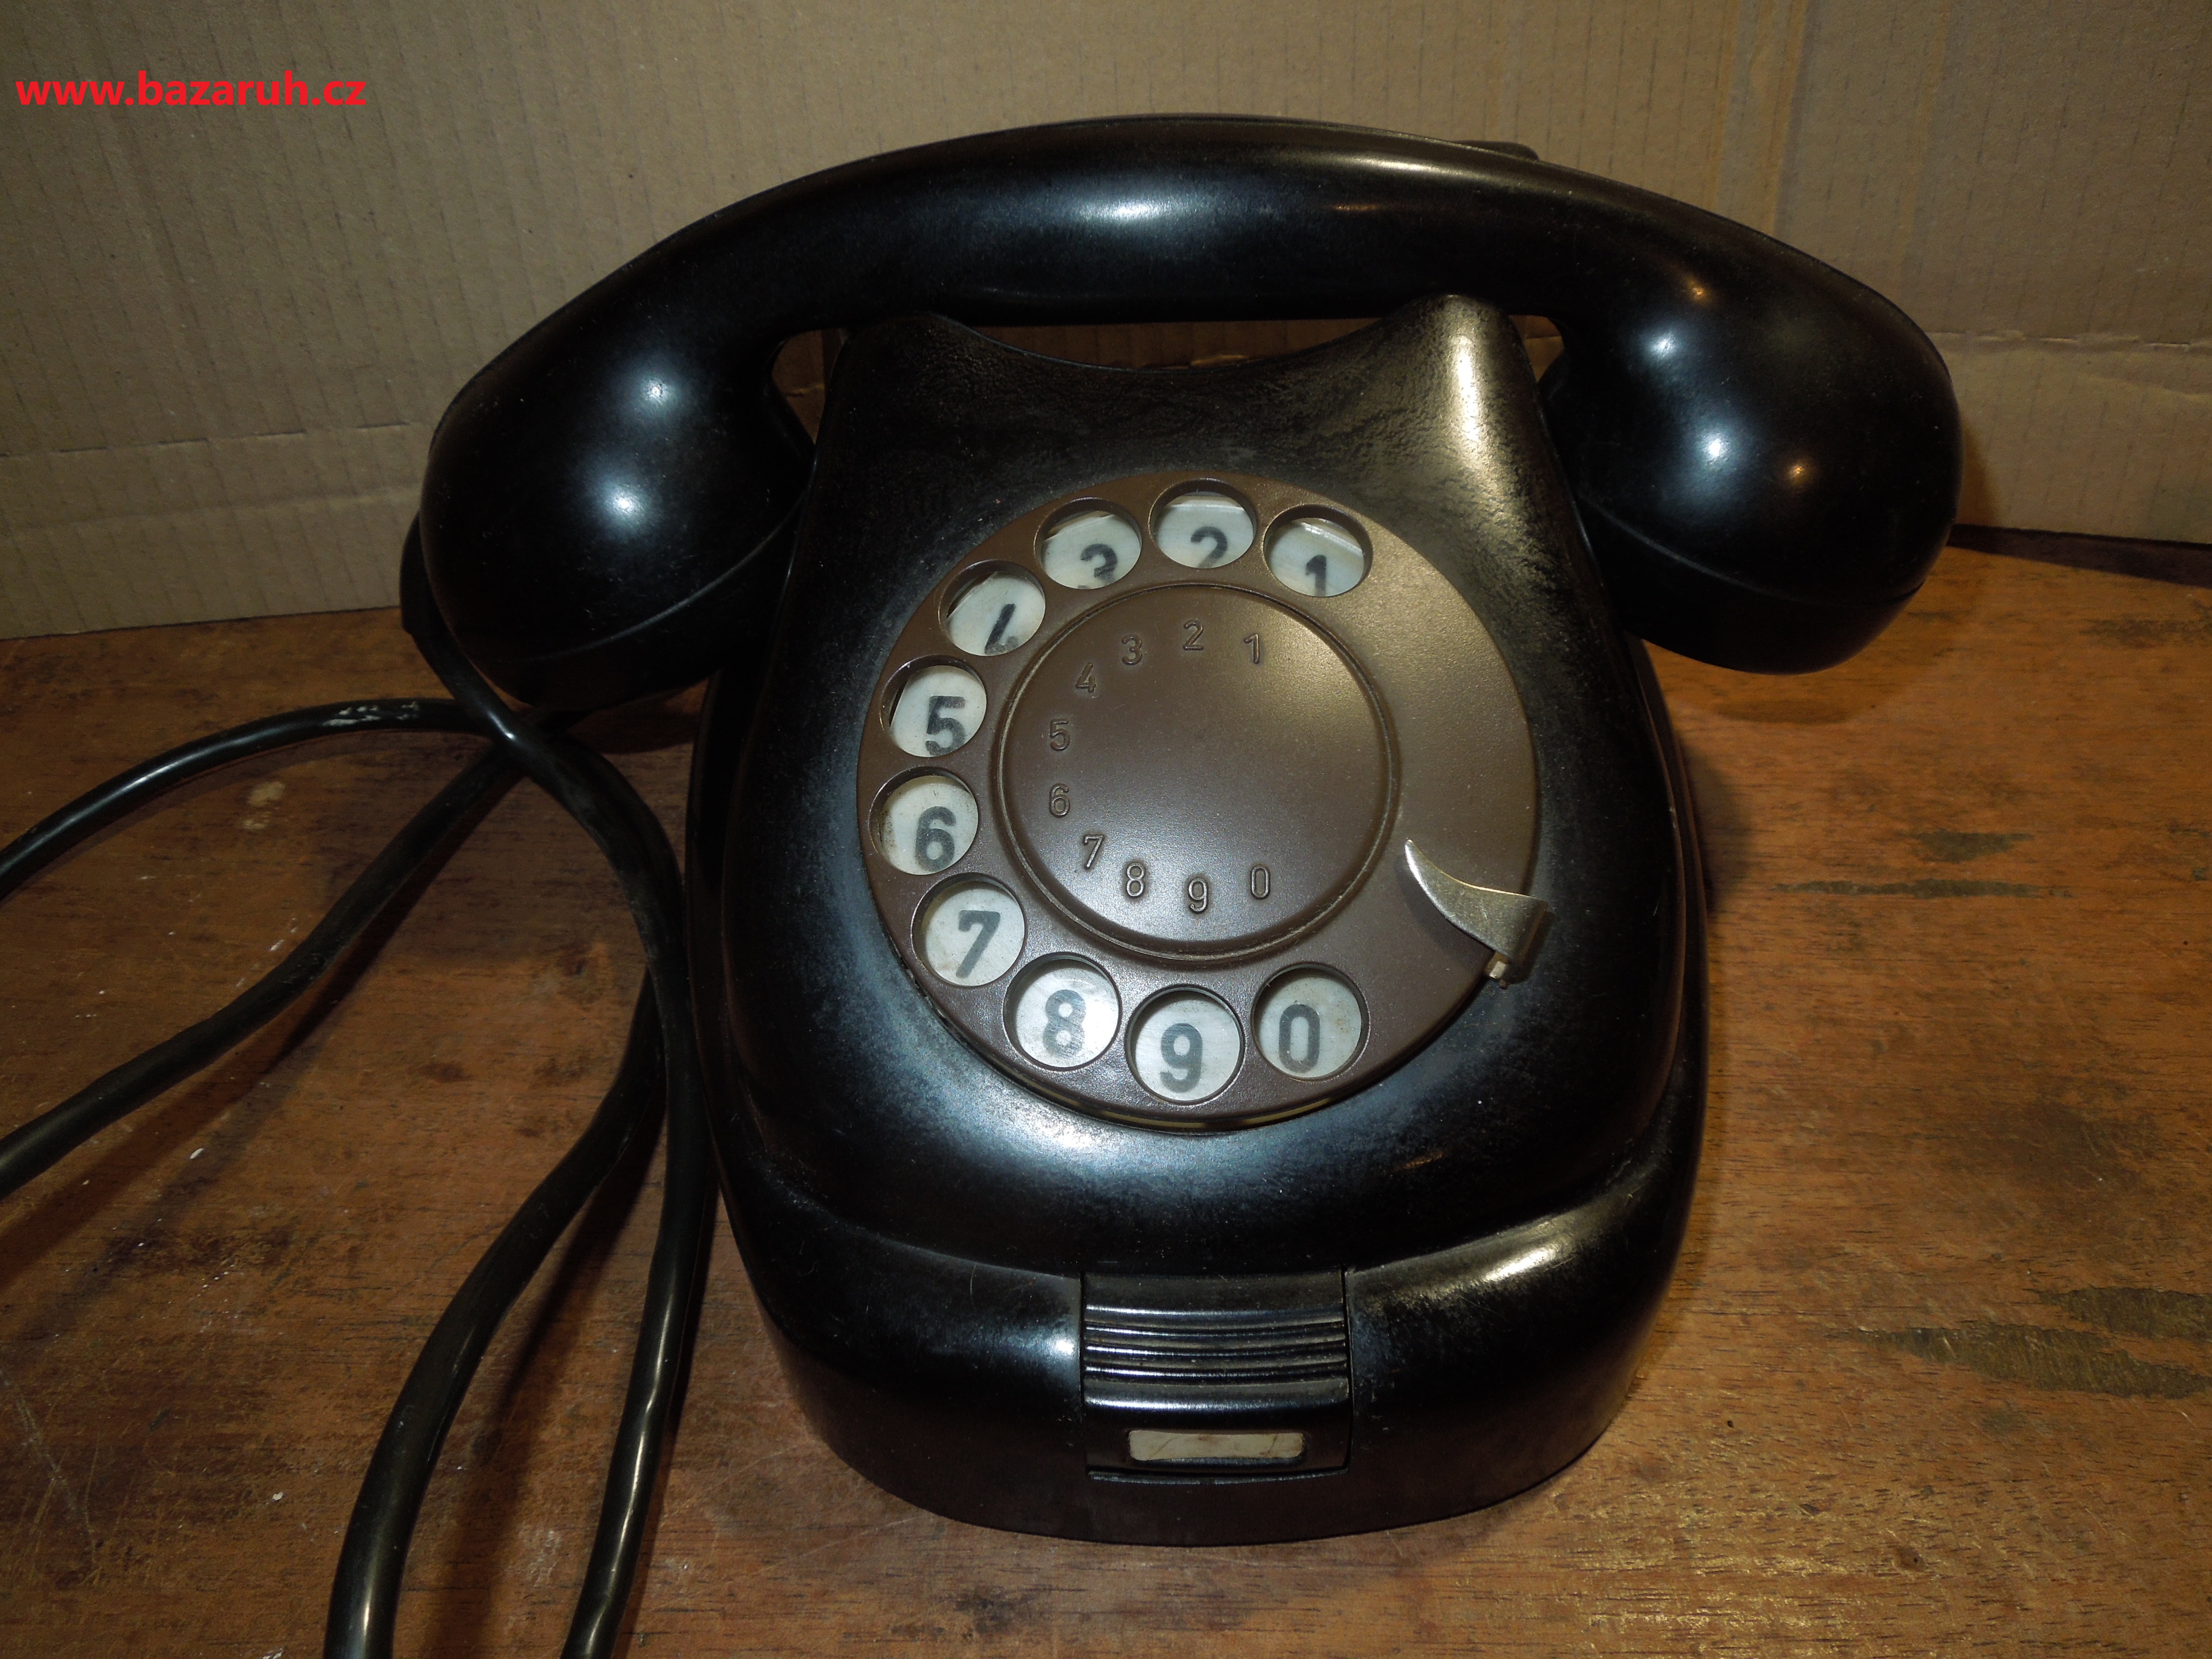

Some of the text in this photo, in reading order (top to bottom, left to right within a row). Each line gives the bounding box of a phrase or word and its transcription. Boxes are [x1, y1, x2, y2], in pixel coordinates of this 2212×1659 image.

[1190, 526, 1228, 568] 2
[1077, 543, 1118, 589] 3
[1305, 554, 1327, 597] 1
[1121, 634, 1142, 666] 3
[1184, 619, 1204, 650] 2
[1244, 633, 1260, 664] 1
[1075, 662, 1097, 693] 4
[926, 696, 966, 756] 5
[1049, 718, 1071, 752] 5
[1048, 783, 1071, 818] 6
[915, 805, 957, 871] 6
[1082, 833, 1105, 870] 7
[1125, 862, 1146, 899] 8
[1187, 877, 1209, 914] 9
[1250, 865, 1271, 900] 0
[956, 910, 1001, 978] 7
[1043, 989, 1086, 1056] 8
[1278, 1004, 1321, 1072] 0
[1159, 1023, 1203, 1093] 9
